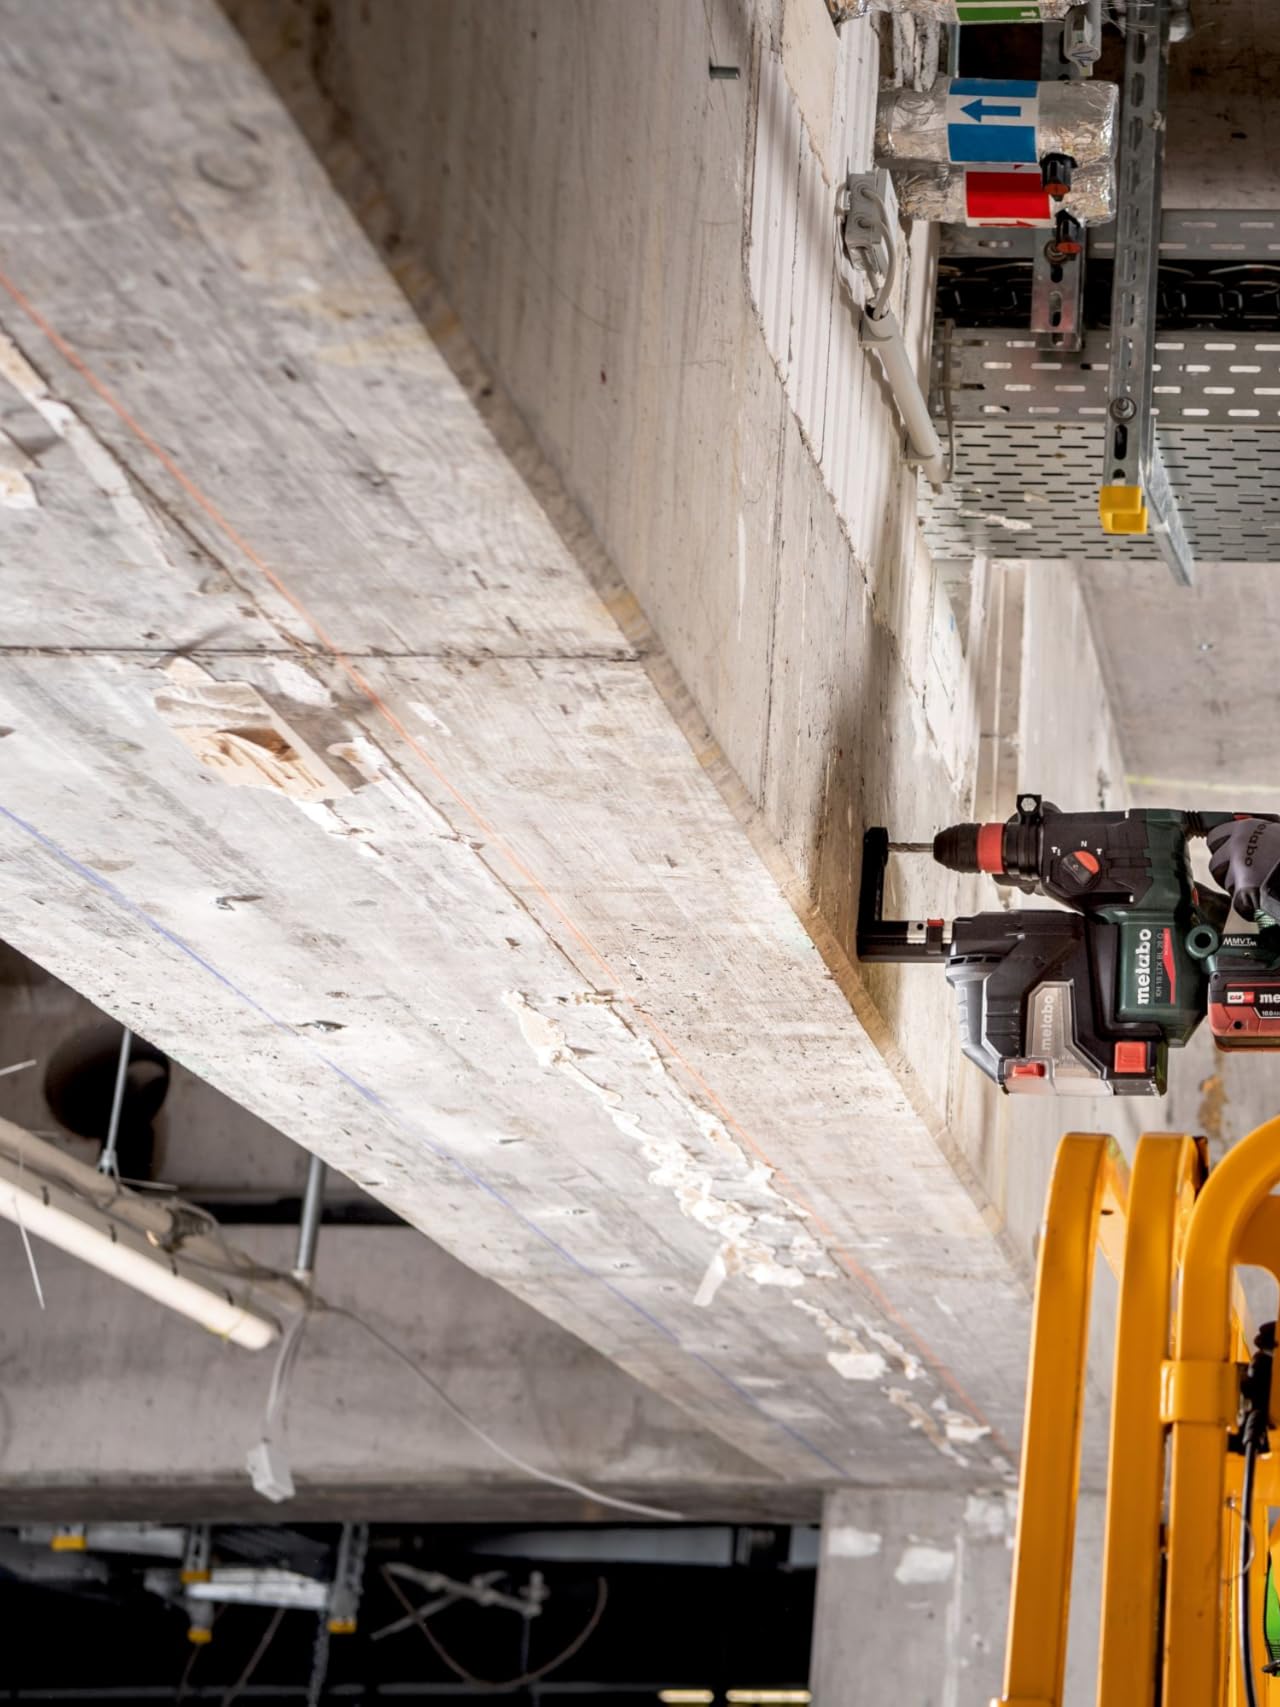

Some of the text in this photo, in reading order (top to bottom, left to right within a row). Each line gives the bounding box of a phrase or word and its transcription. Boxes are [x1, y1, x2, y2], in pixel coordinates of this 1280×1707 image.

[1245, 822, 1267, 867] etabo
[1136, 929, 1151, 1004] metabo
[1040, 995, 1054, 1051] metabo
